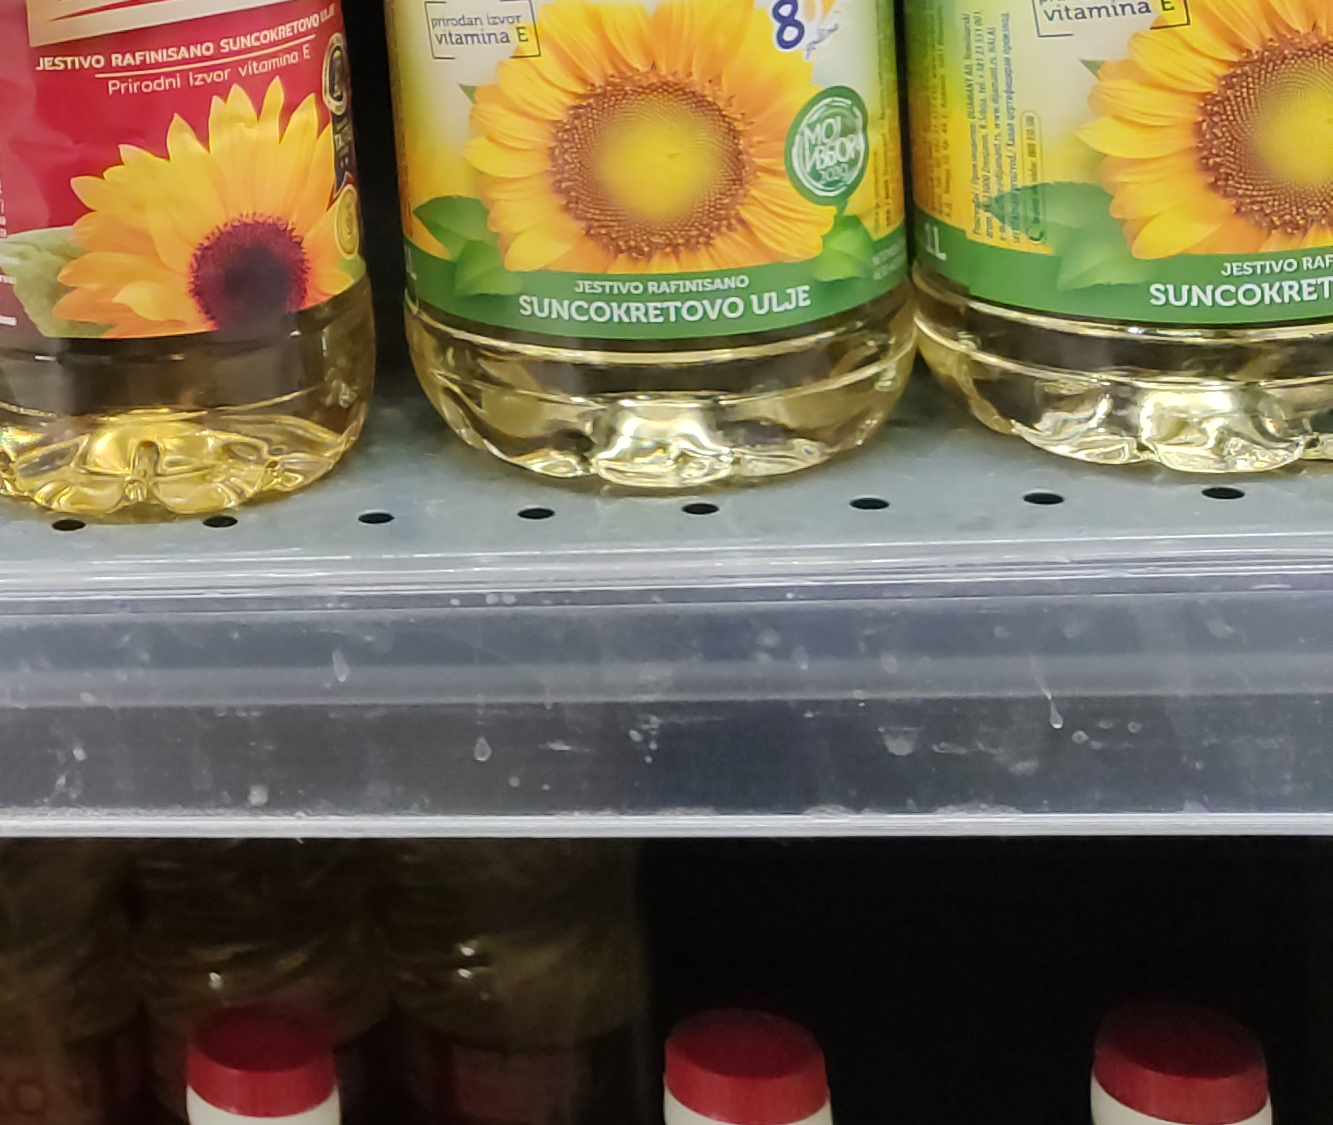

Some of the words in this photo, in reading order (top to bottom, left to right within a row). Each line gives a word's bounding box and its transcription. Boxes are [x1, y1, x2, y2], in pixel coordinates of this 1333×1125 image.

[431, 14, 483, 29] prirodan
[487, 12, 522, 26] izvor
[1043, 0, 1152, 22] vitamina
[35, 54, 105, 71] JESTIVO
[112, 42, 214, 67] RAFINISANO
[220, 13, 320, 53] SUNCOKRETOVO
[435, 28, 511, 46] vitamina
[517, 26, 529, 43] E
[108, 73, 181, 95] Prirodni
[189, 67, 231, 87] izvor
[238, 49, 299, 77] vitamina
[303, 44, 311, 60] E
[1220, 259, 1298, 277] JESTIVO
[574, 280, 644, 295] JESTIVO
[647, 275, 749, 294] RAFINISANO
[1149, 276, 1333, 307] SUNCOKRET
[519, 295, 744, 323] SUNCOKRETOVO
[751, 285, 811, 315] ULJE
